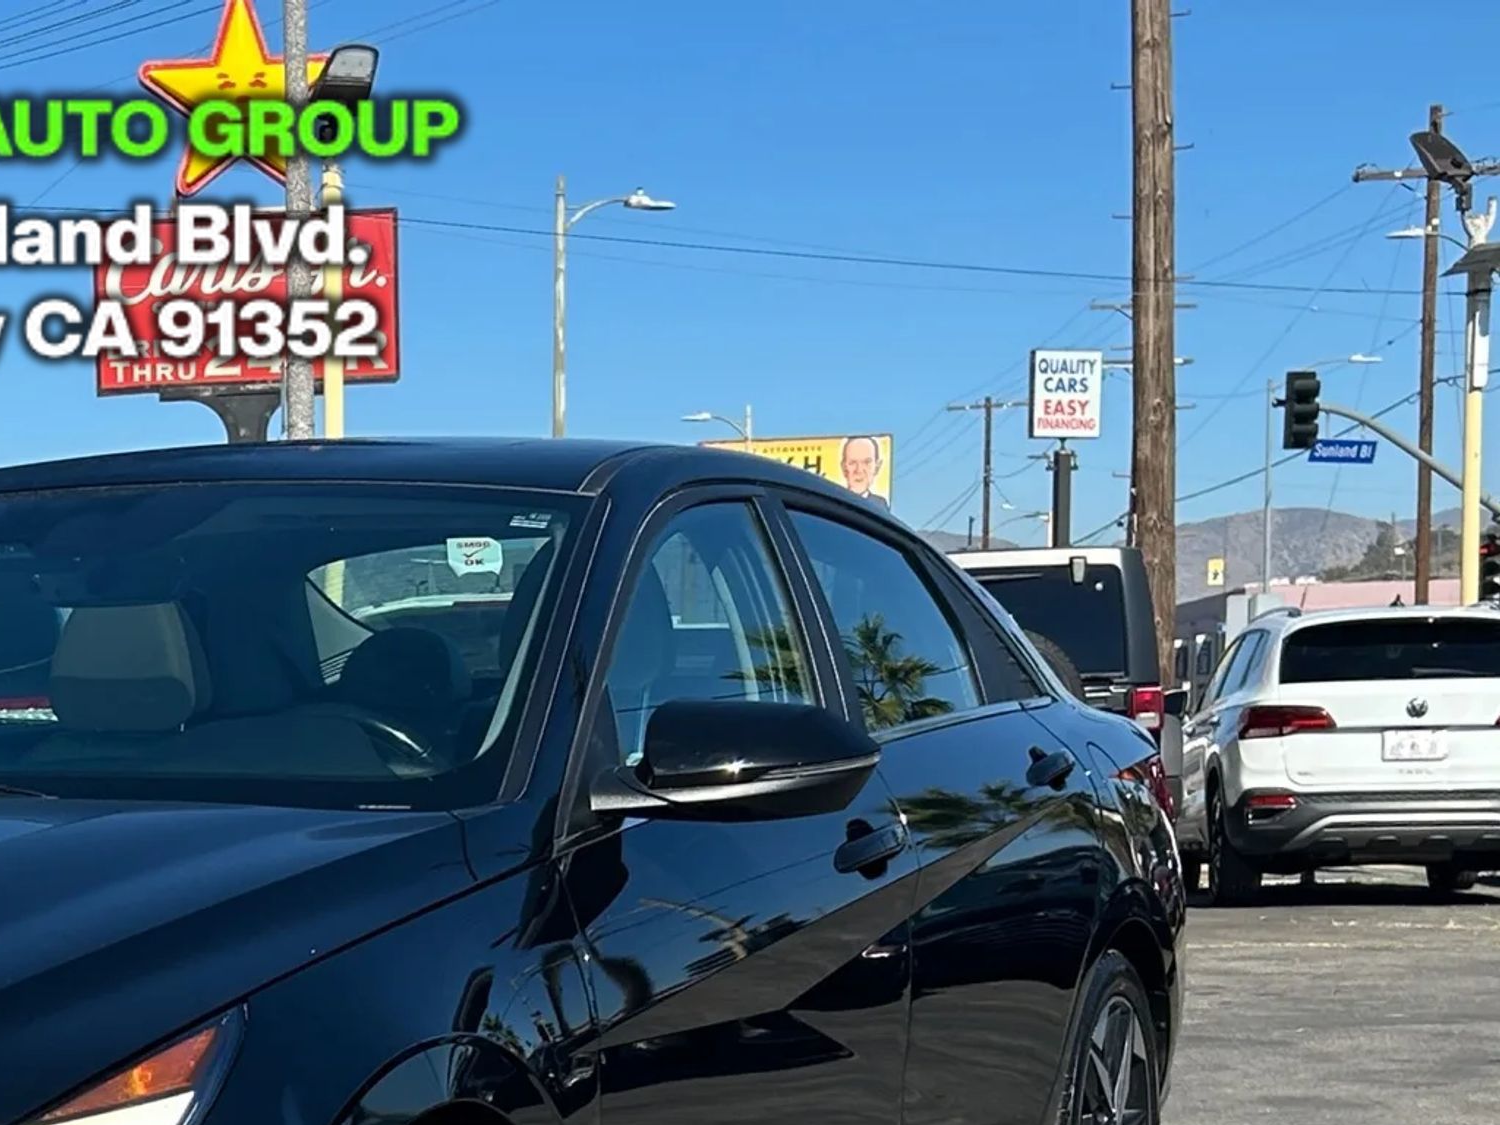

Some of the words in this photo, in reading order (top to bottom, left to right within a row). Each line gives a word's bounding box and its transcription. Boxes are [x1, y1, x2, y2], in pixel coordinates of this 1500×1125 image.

[109, 361, 196, 384] THRU
[1038, 358, 1097, 375] QUALITY
[1043, 377, 1089, 393] CARS
[1043, 399, 1089, 416] EASY
[1037, 417, 1096, 430] FINANCING
[1313, 442, 1359, 458] Sunland
[464, 558, 485, 566] OK
